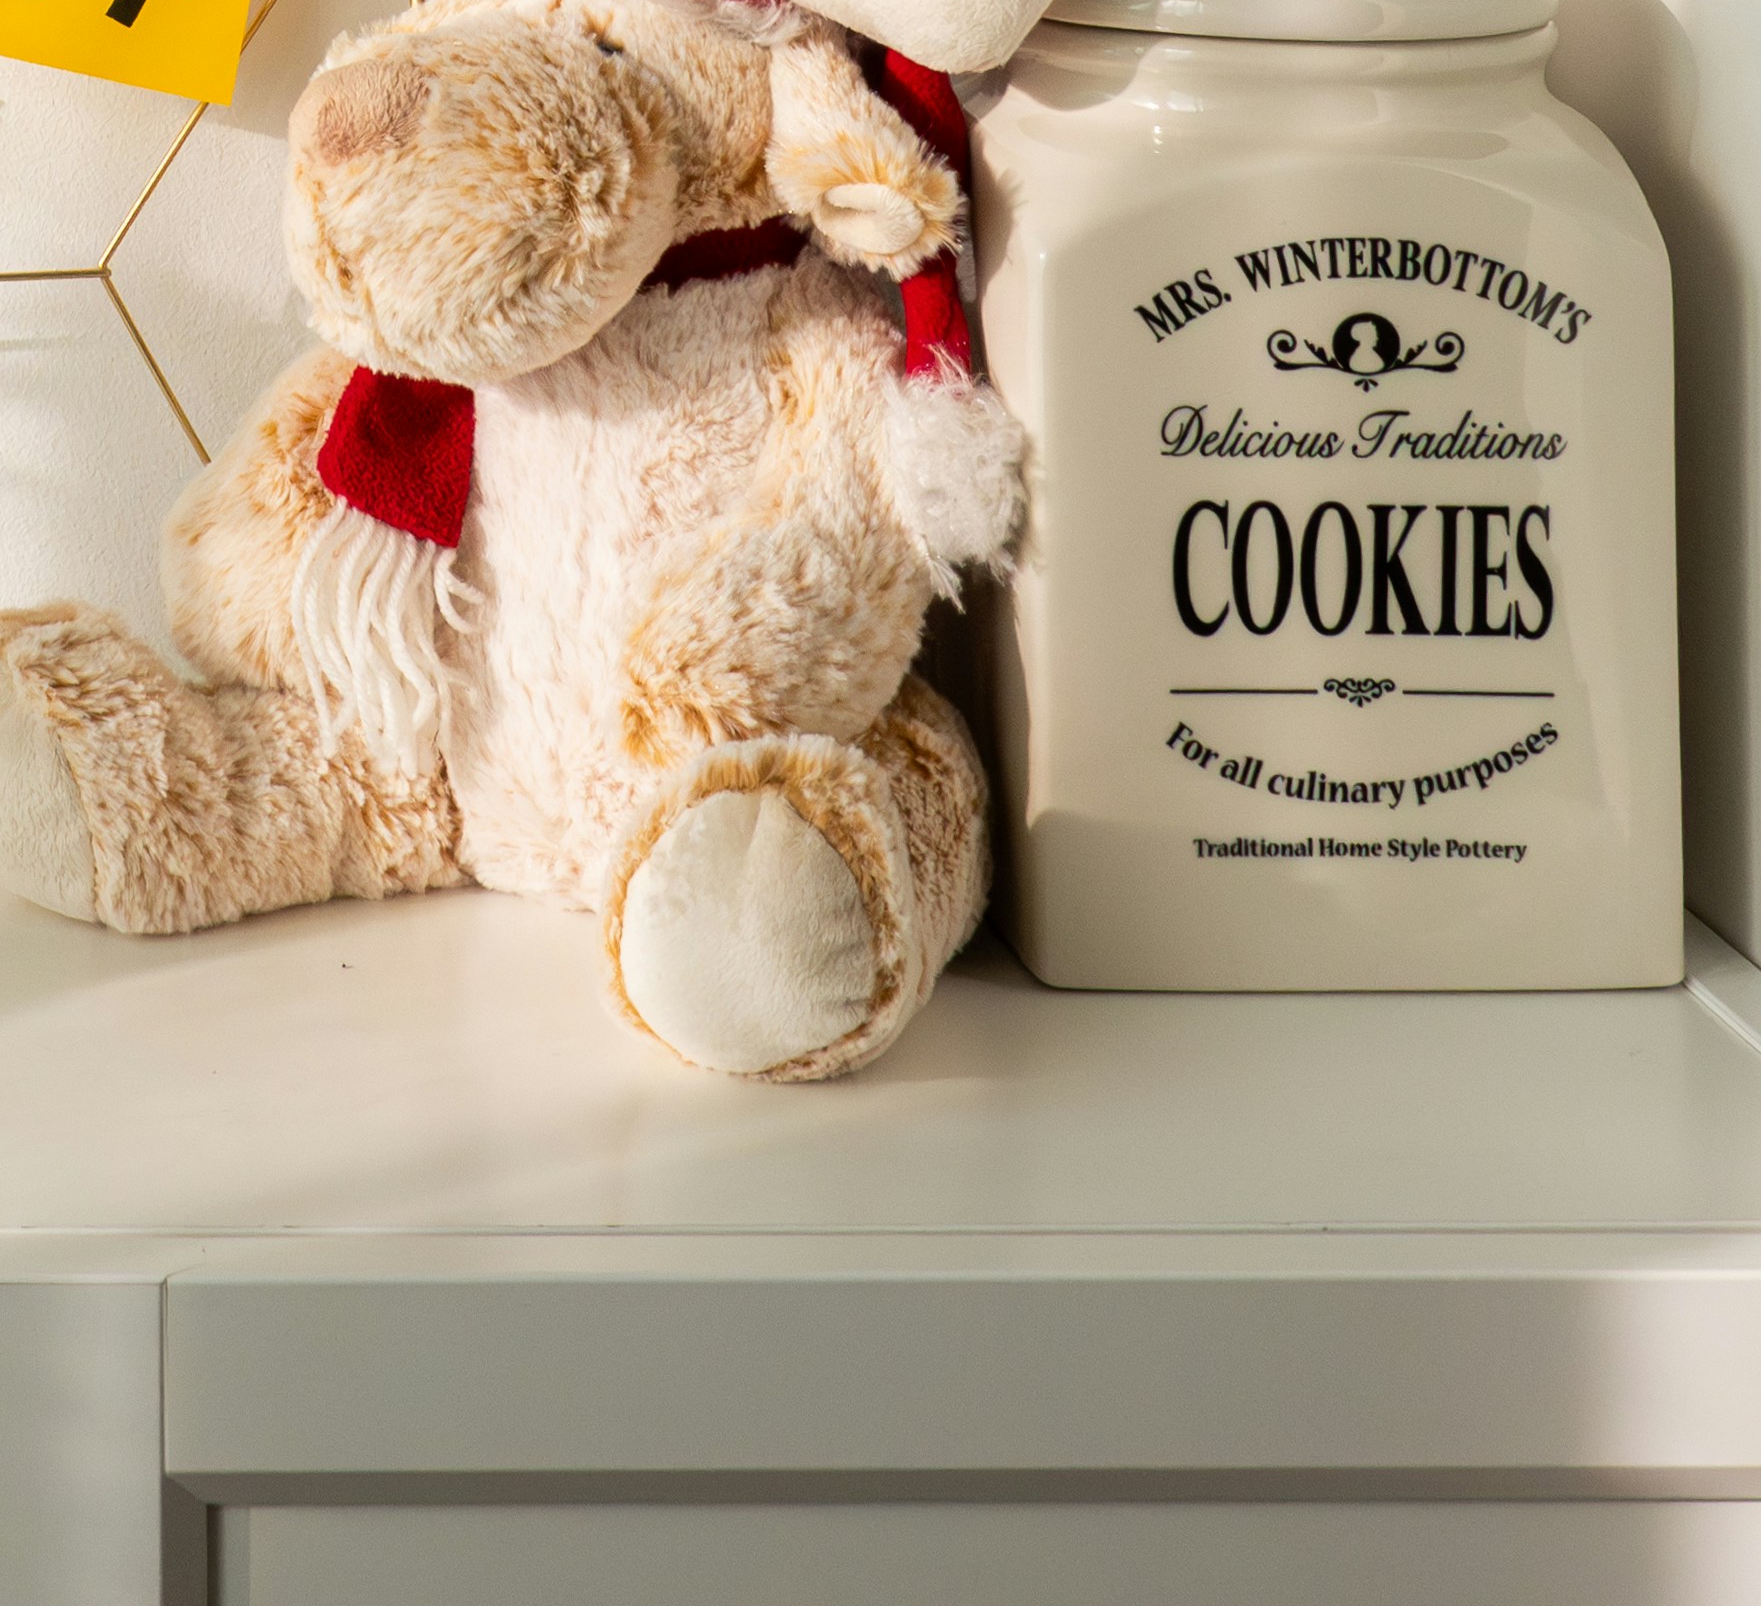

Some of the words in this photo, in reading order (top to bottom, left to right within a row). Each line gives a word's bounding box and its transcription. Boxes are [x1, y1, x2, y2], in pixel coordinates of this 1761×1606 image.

[1134, 269, 1231, 343] MRS.
[1235, 238, 1592, 345] WINTERBOTTOM'S
[1161, 405, 1344, 458] Delicious
[1352, 410, 1565, 460] Traditions
[1173, 500, 1553, 640] COOKIES
[1166, 722, 1219, 768] For
[1220, 757, 1263, 789] all
[1268, 771, 1405, 809] culinary
[1413, 723, 1558, 805] purposes
[1193, 838, 1313, 857] Traditional
[1319, 838, 1382, 857] Home
[1388, 838, 1440, 862] Style
[1446, 839, 1527, 863] Pottery
